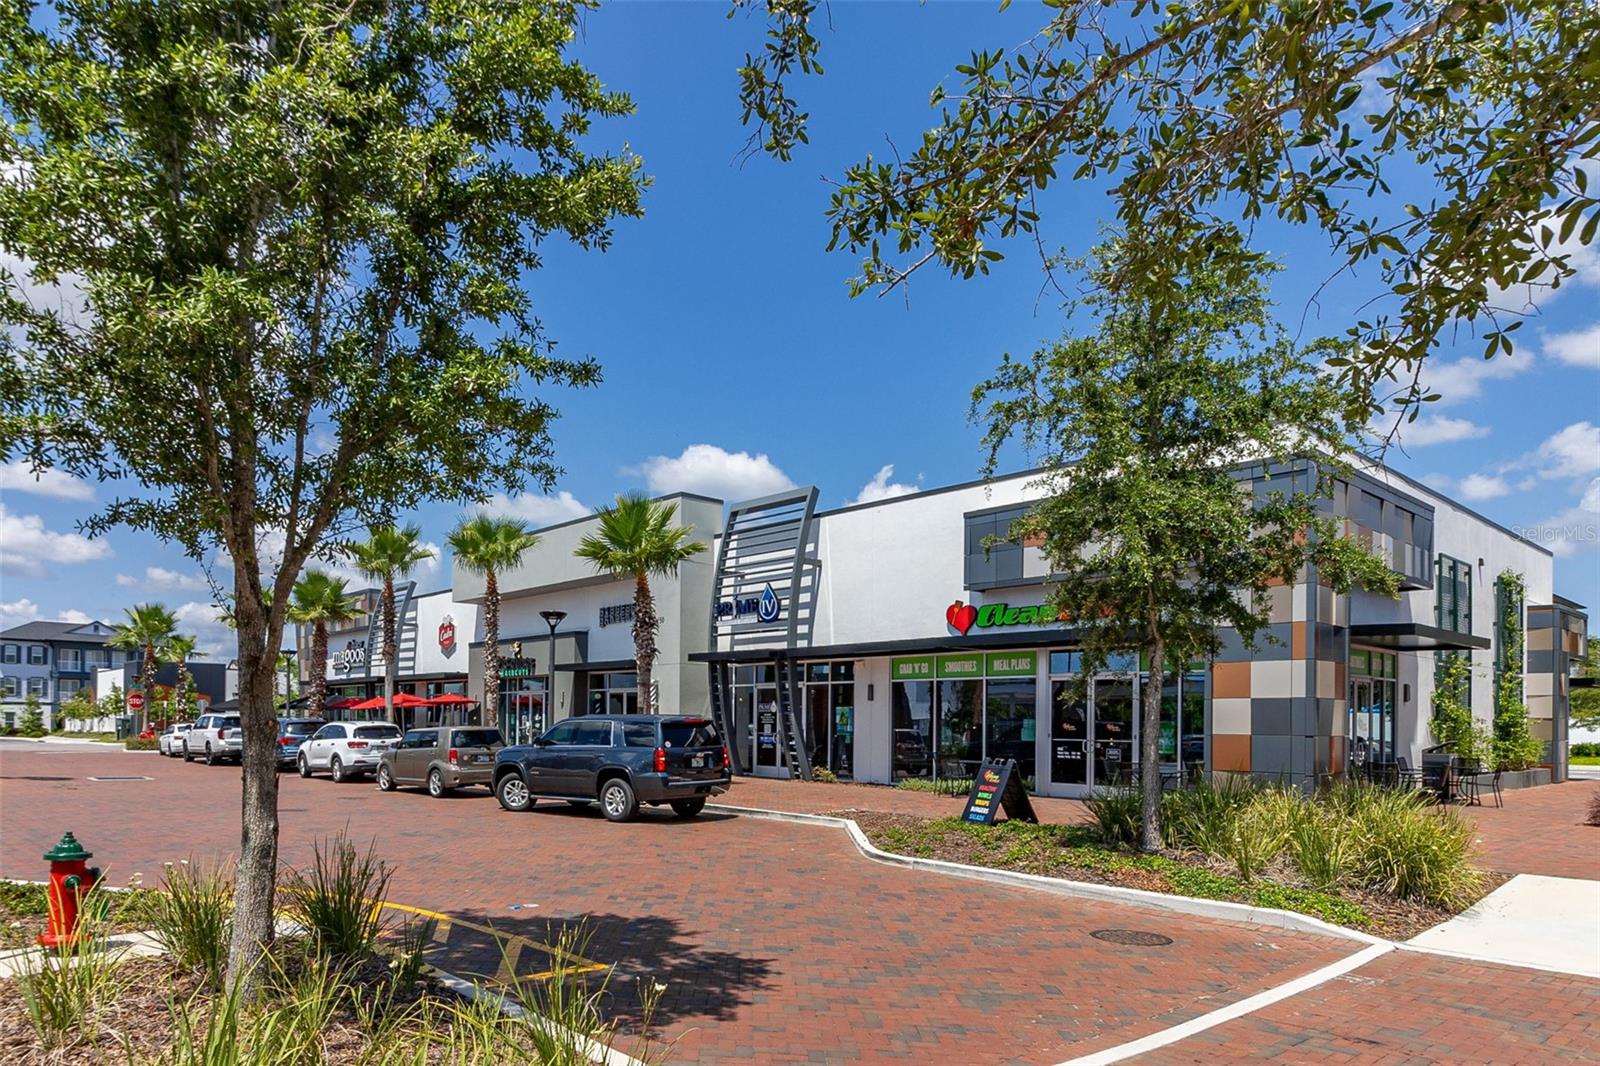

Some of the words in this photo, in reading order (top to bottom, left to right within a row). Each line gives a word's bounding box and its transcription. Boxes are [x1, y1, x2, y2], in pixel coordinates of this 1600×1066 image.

[762, 599, 774, 613] IV
[944, 661, 977, 673] SMOOTHIES
[993, 659, 1010, 671] MEAL
[1011, 658, 1031, 670] PLANS
